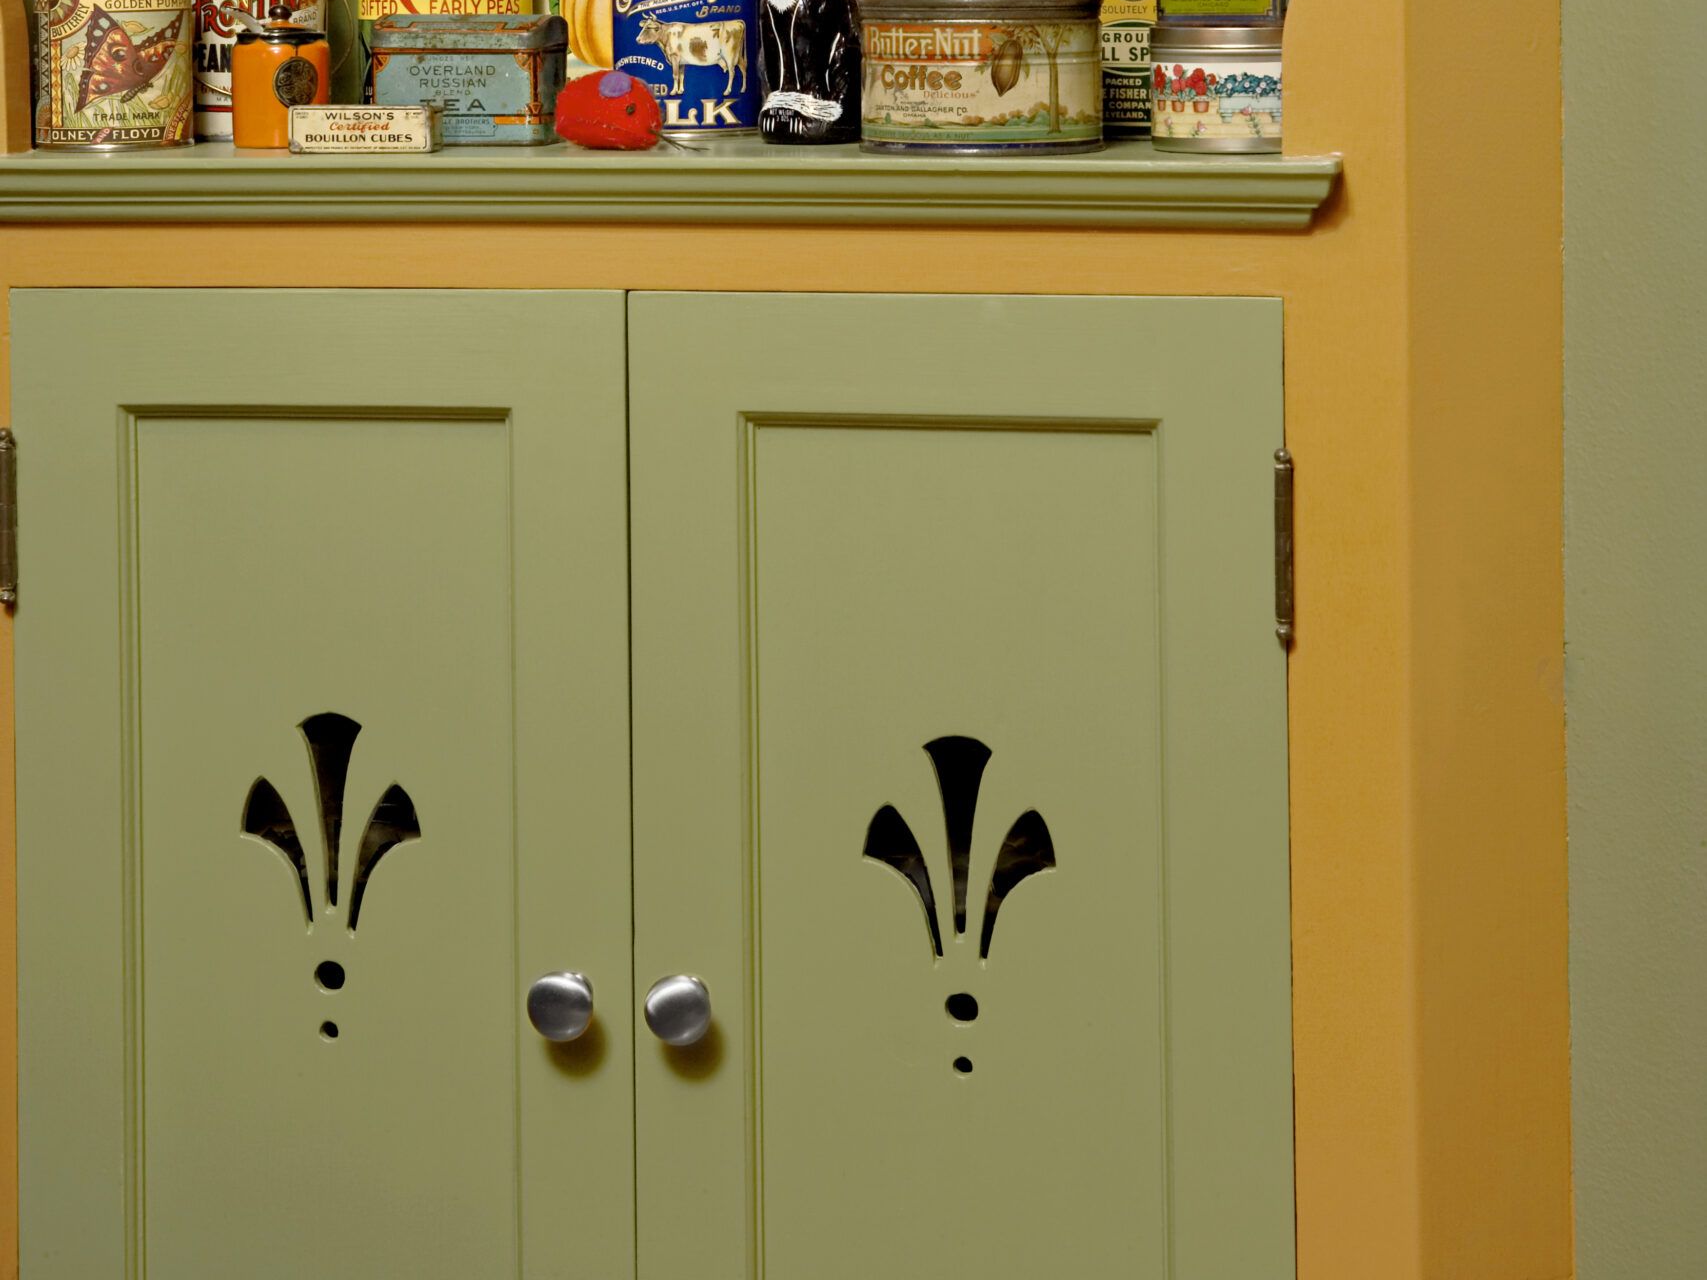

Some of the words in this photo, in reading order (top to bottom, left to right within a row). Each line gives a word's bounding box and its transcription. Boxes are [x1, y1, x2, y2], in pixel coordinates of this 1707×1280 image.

[104, 0, 152, 9] GOLDEN
[361, 0, 398, 16] SIFTED
[429, 0, 482, 15] EARLY
[1101, 5, 1148, 14] SOLUTELY
[696, 5, 742, 18] BRAND
[51, 3, 90, 38] BUTTERFLY
[292, 11, 317, 24] BRAND
[870, 26, 983, 60] Butter-Nut
[1102, 32, 1150, 43] GROU
[1101, 47, 1120, 61] LL
[409, 65, 496, 76] OVERLAND
[419, 78, 487, 88] RUSSIAN
[881, 64, 963, 91] Coffee
[1105, 78, 1142, 86] PACKED
[1109, 88, 1147, 99] FISHER
[419, 98, 486, 111] TEA
[1108, 101, 1151, 109] COMPAN
[93, 113, 128, 121] TRADE
[132, 112, 160, 120] MARK
[325, 112, 395, 120] WILSON'S
[329, 121, 391, 133] Certified
[51, 131, 95, 141] OLNEY
[112, 128, 161, 139] FLOYD
[305, 134, 366, 143] BOUILLON
[370, 134, 413, 143] CUBES
